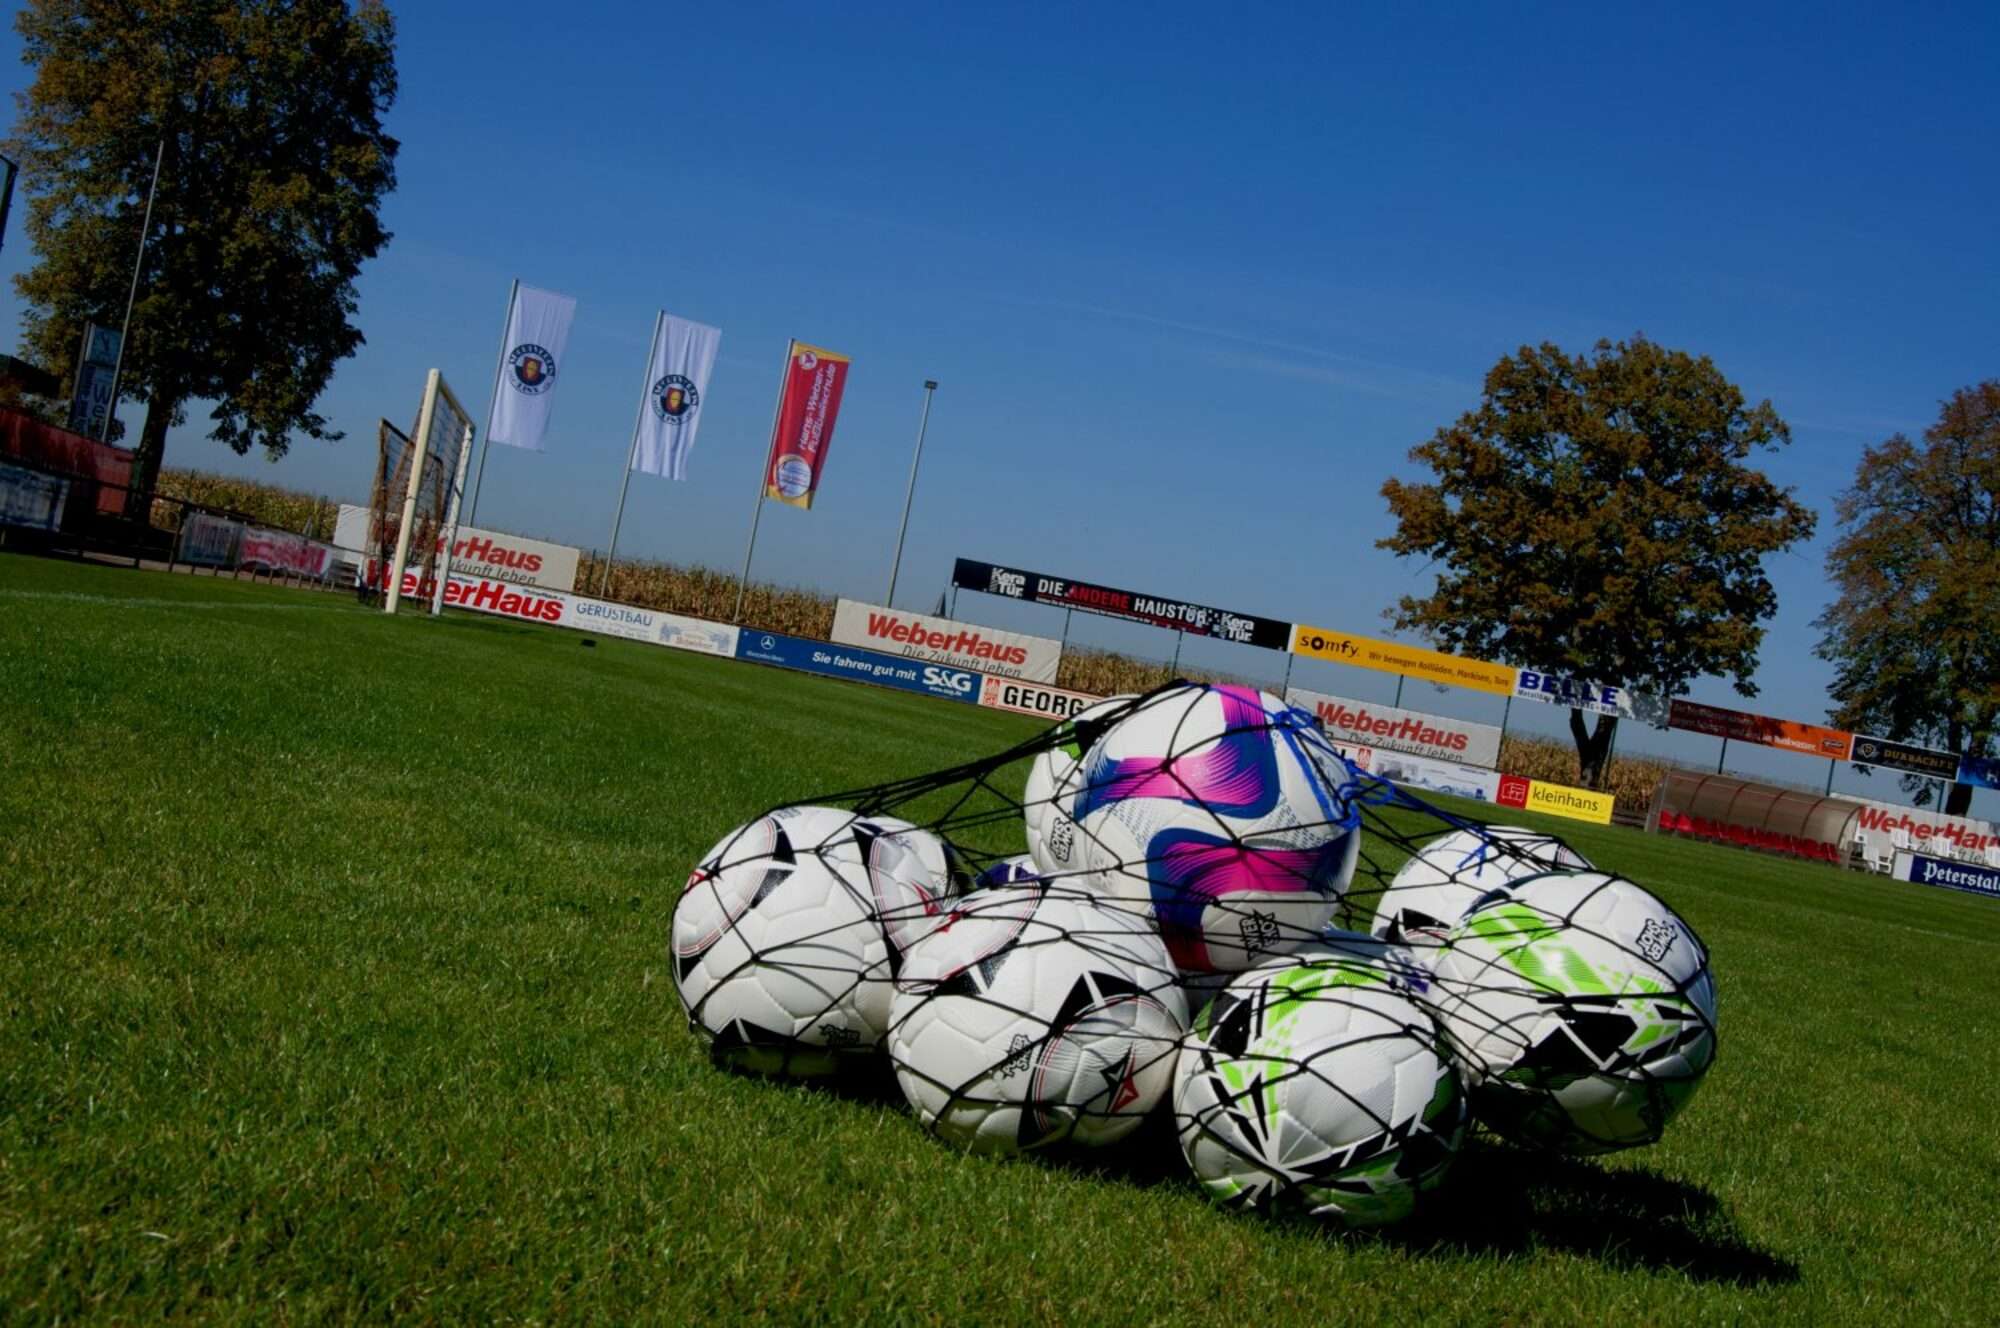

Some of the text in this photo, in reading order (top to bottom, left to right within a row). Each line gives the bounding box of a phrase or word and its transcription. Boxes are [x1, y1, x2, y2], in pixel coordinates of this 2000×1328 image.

[1067, 583, 1131, 610] ANDERE
[867, 612, 1028, 665] WeberHaus
[1300, 635, 1359, 658] somfy
[812, 651, 917, 681] Sie fahren gut mit
[902, 644, 925, 658] Die
[928, 650, 980, 671] Zukunft
[921, 666, 973, 692] S&G
[1003, 685, 1085, 717] GEORG
[1316, 701, 1469, 751] WeberHaus
[1375, 736, 1424, 754] Zukunft
[1532, 785, 1599, 812] kleinhans
[1858, 805, 2000, 851] WeberHau
